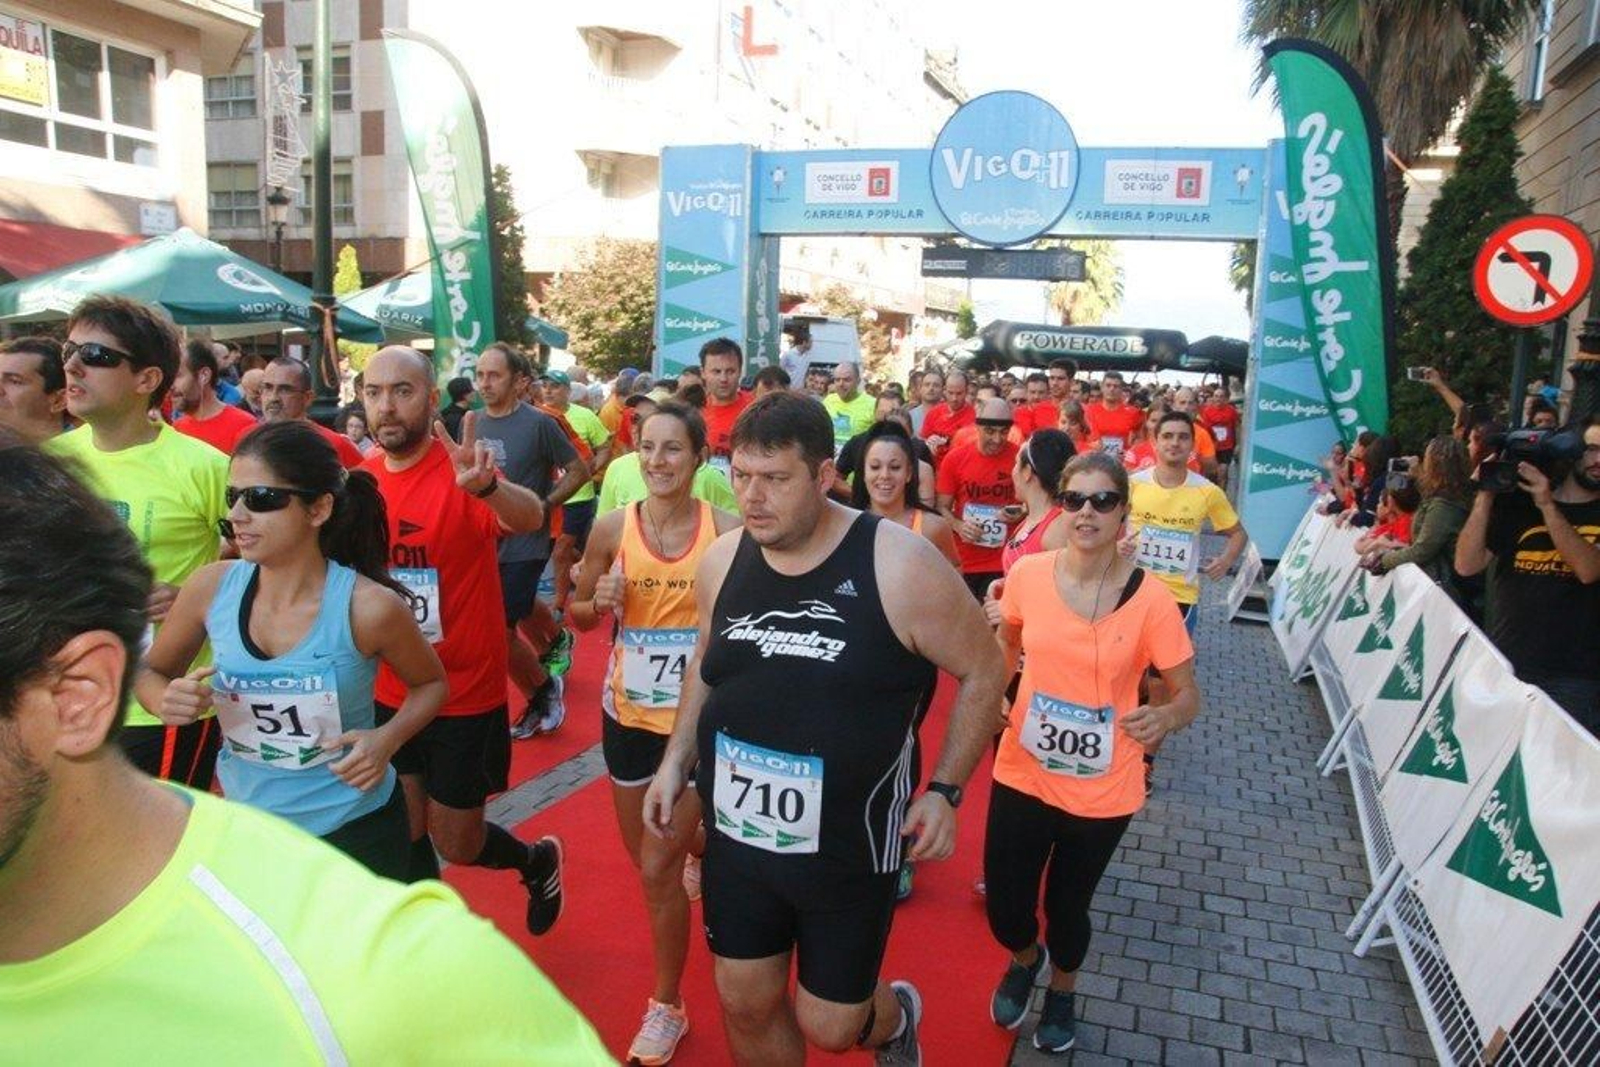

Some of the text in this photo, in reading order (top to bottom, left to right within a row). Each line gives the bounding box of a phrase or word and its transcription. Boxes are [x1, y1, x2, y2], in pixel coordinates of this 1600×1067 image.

[817, 174, 862, 182] CONCELLO
[1118, 173, 1170, 182] CONCELLO
[1123, 182, 1163, 191] DE VIGO
[822, 183, 857, 191] DE VIGO
[804, 209, 925, 219] CARREIRA POPULAR
[1076, 210, 1211, 222] CARREIRA POPULAR
[240, 302, 310, 319] MONDARI
[1020, 332, 1146, 355] POWERADE
[1141, 543, 1186, 562] 1114
[727, 625, 847, 652] alejandro
[760, 641, 840, 662] gomez
[251, 703, 311, 738] 51
[1036, 722, 1102, 759] 308
[730, 772, 805, 824] 710
